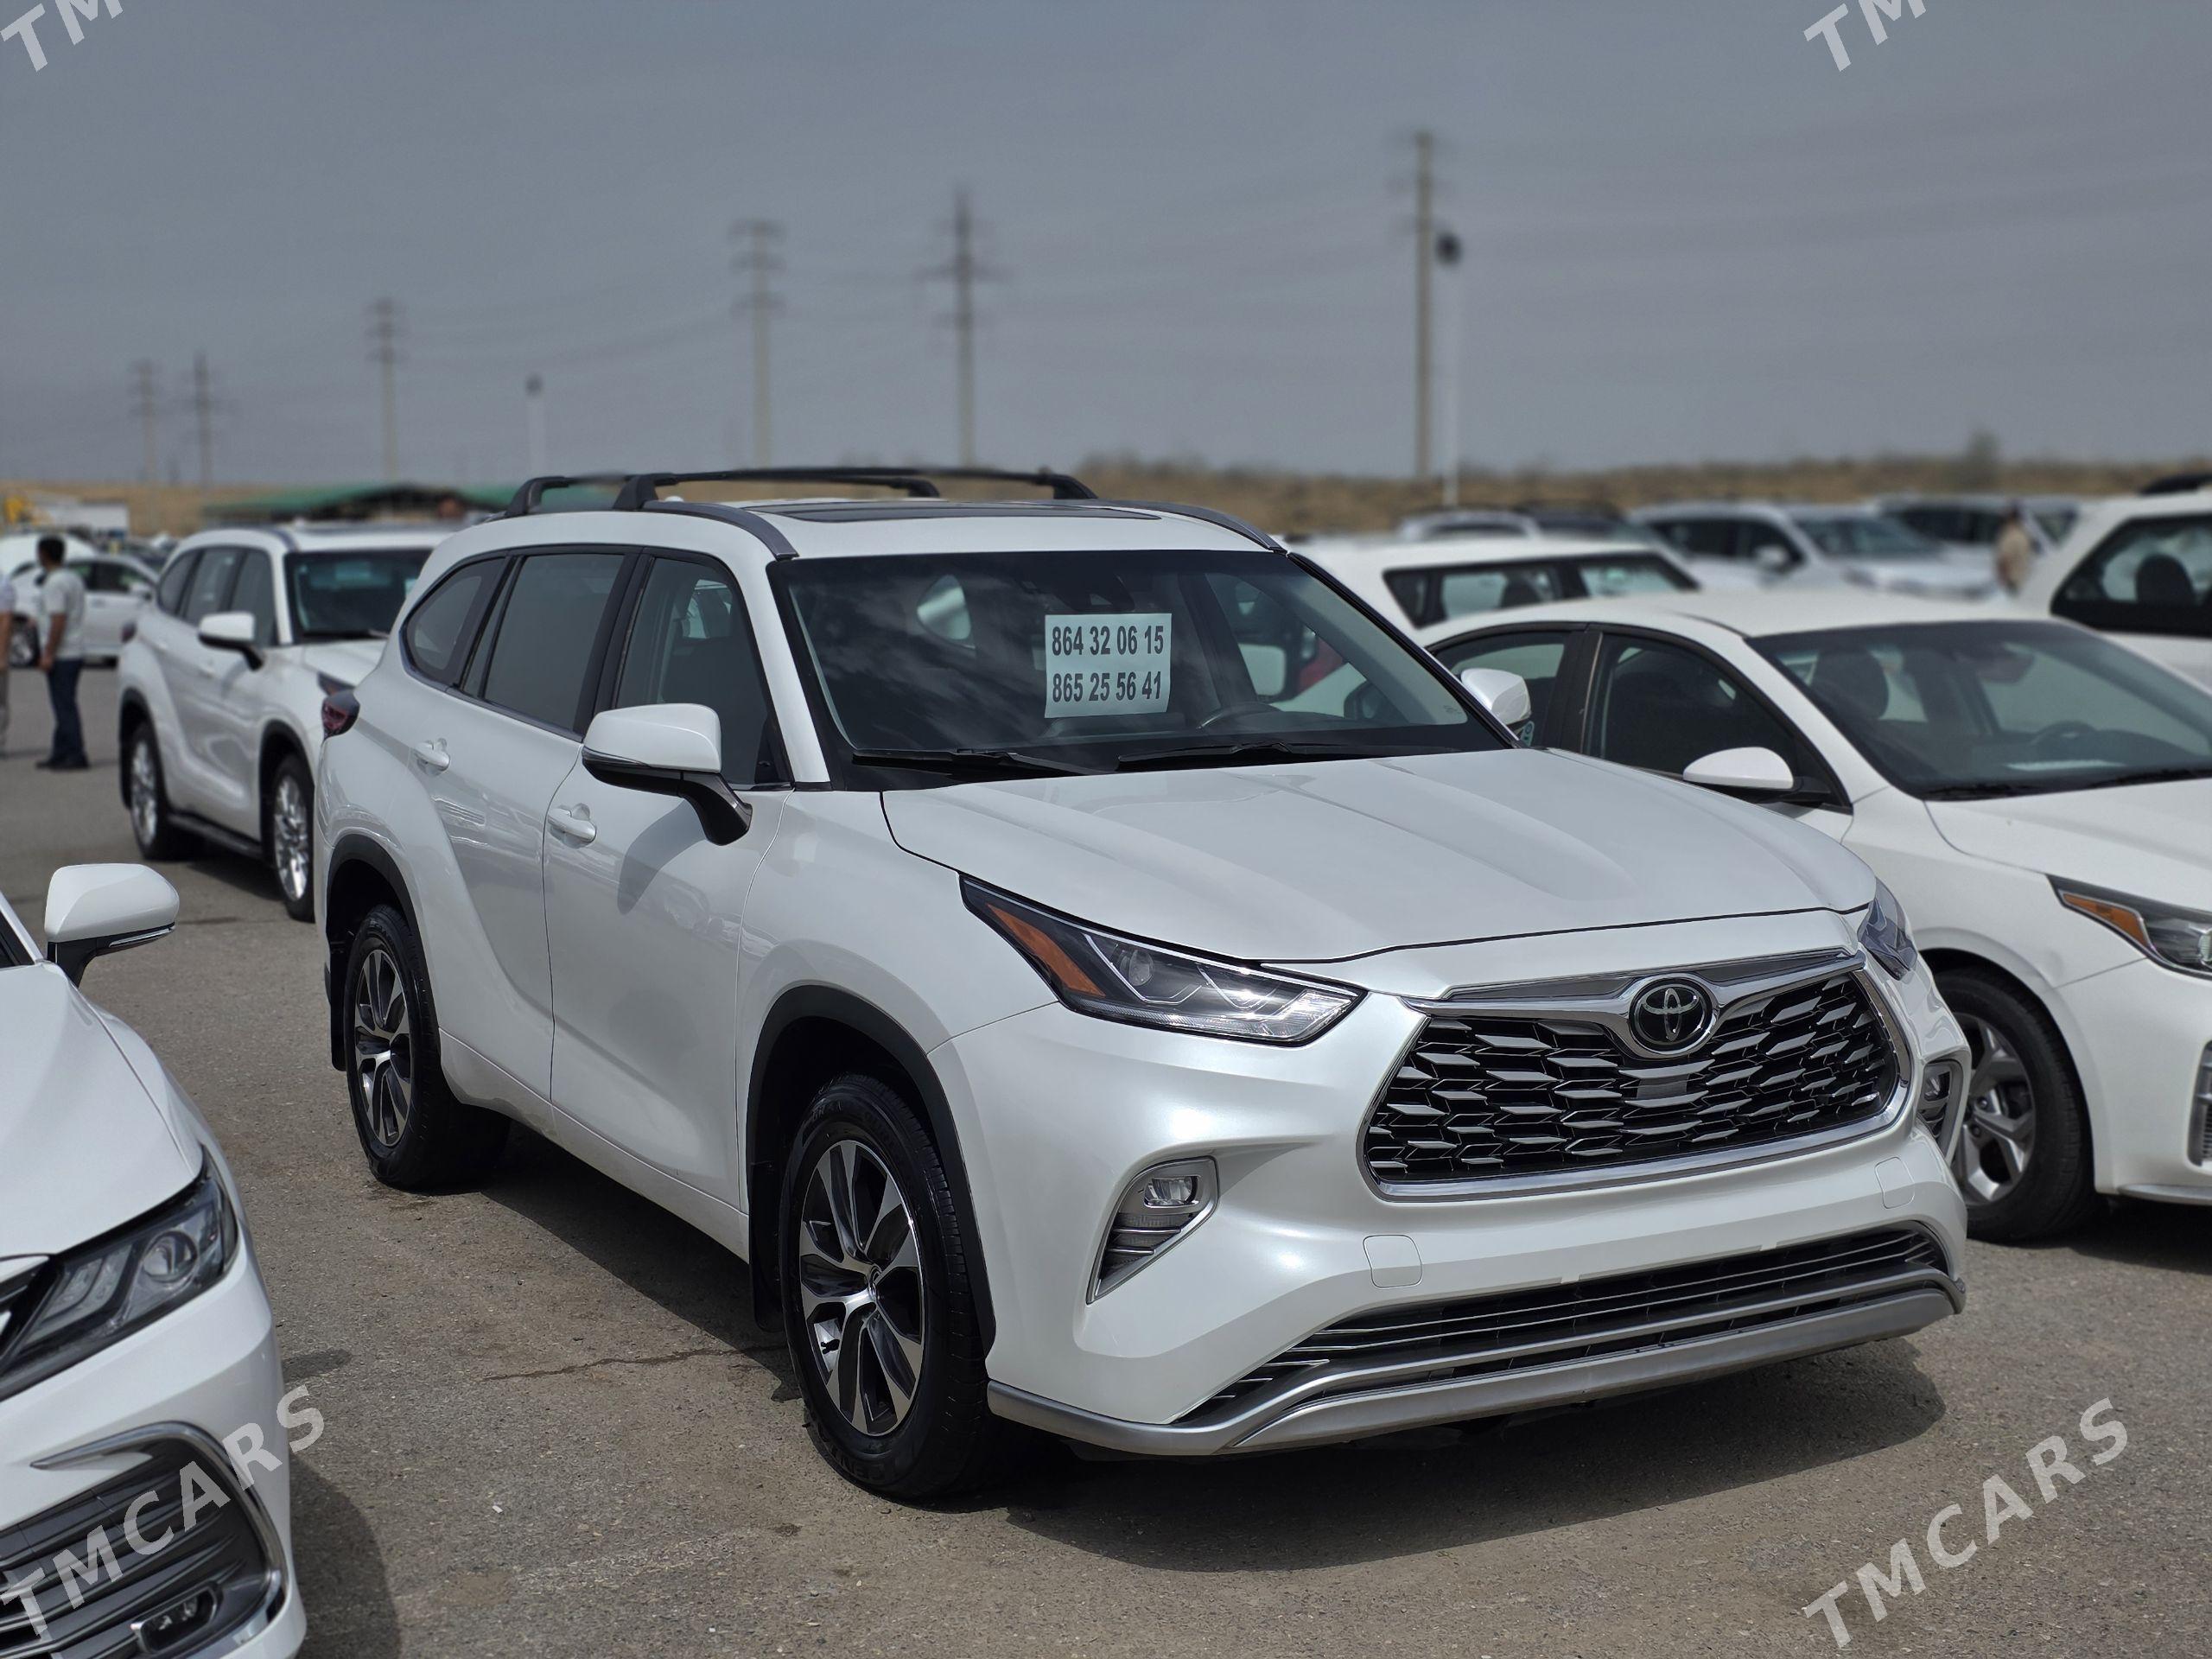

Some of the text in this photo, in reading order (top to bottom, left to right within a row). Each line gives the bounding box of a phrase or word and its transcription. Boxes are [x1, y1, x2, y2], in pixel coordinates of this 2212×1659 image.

[1052, 625, 1164, 656] 864 32 06 15
[1052, 671, 1161, 702] 865 25 56 41
